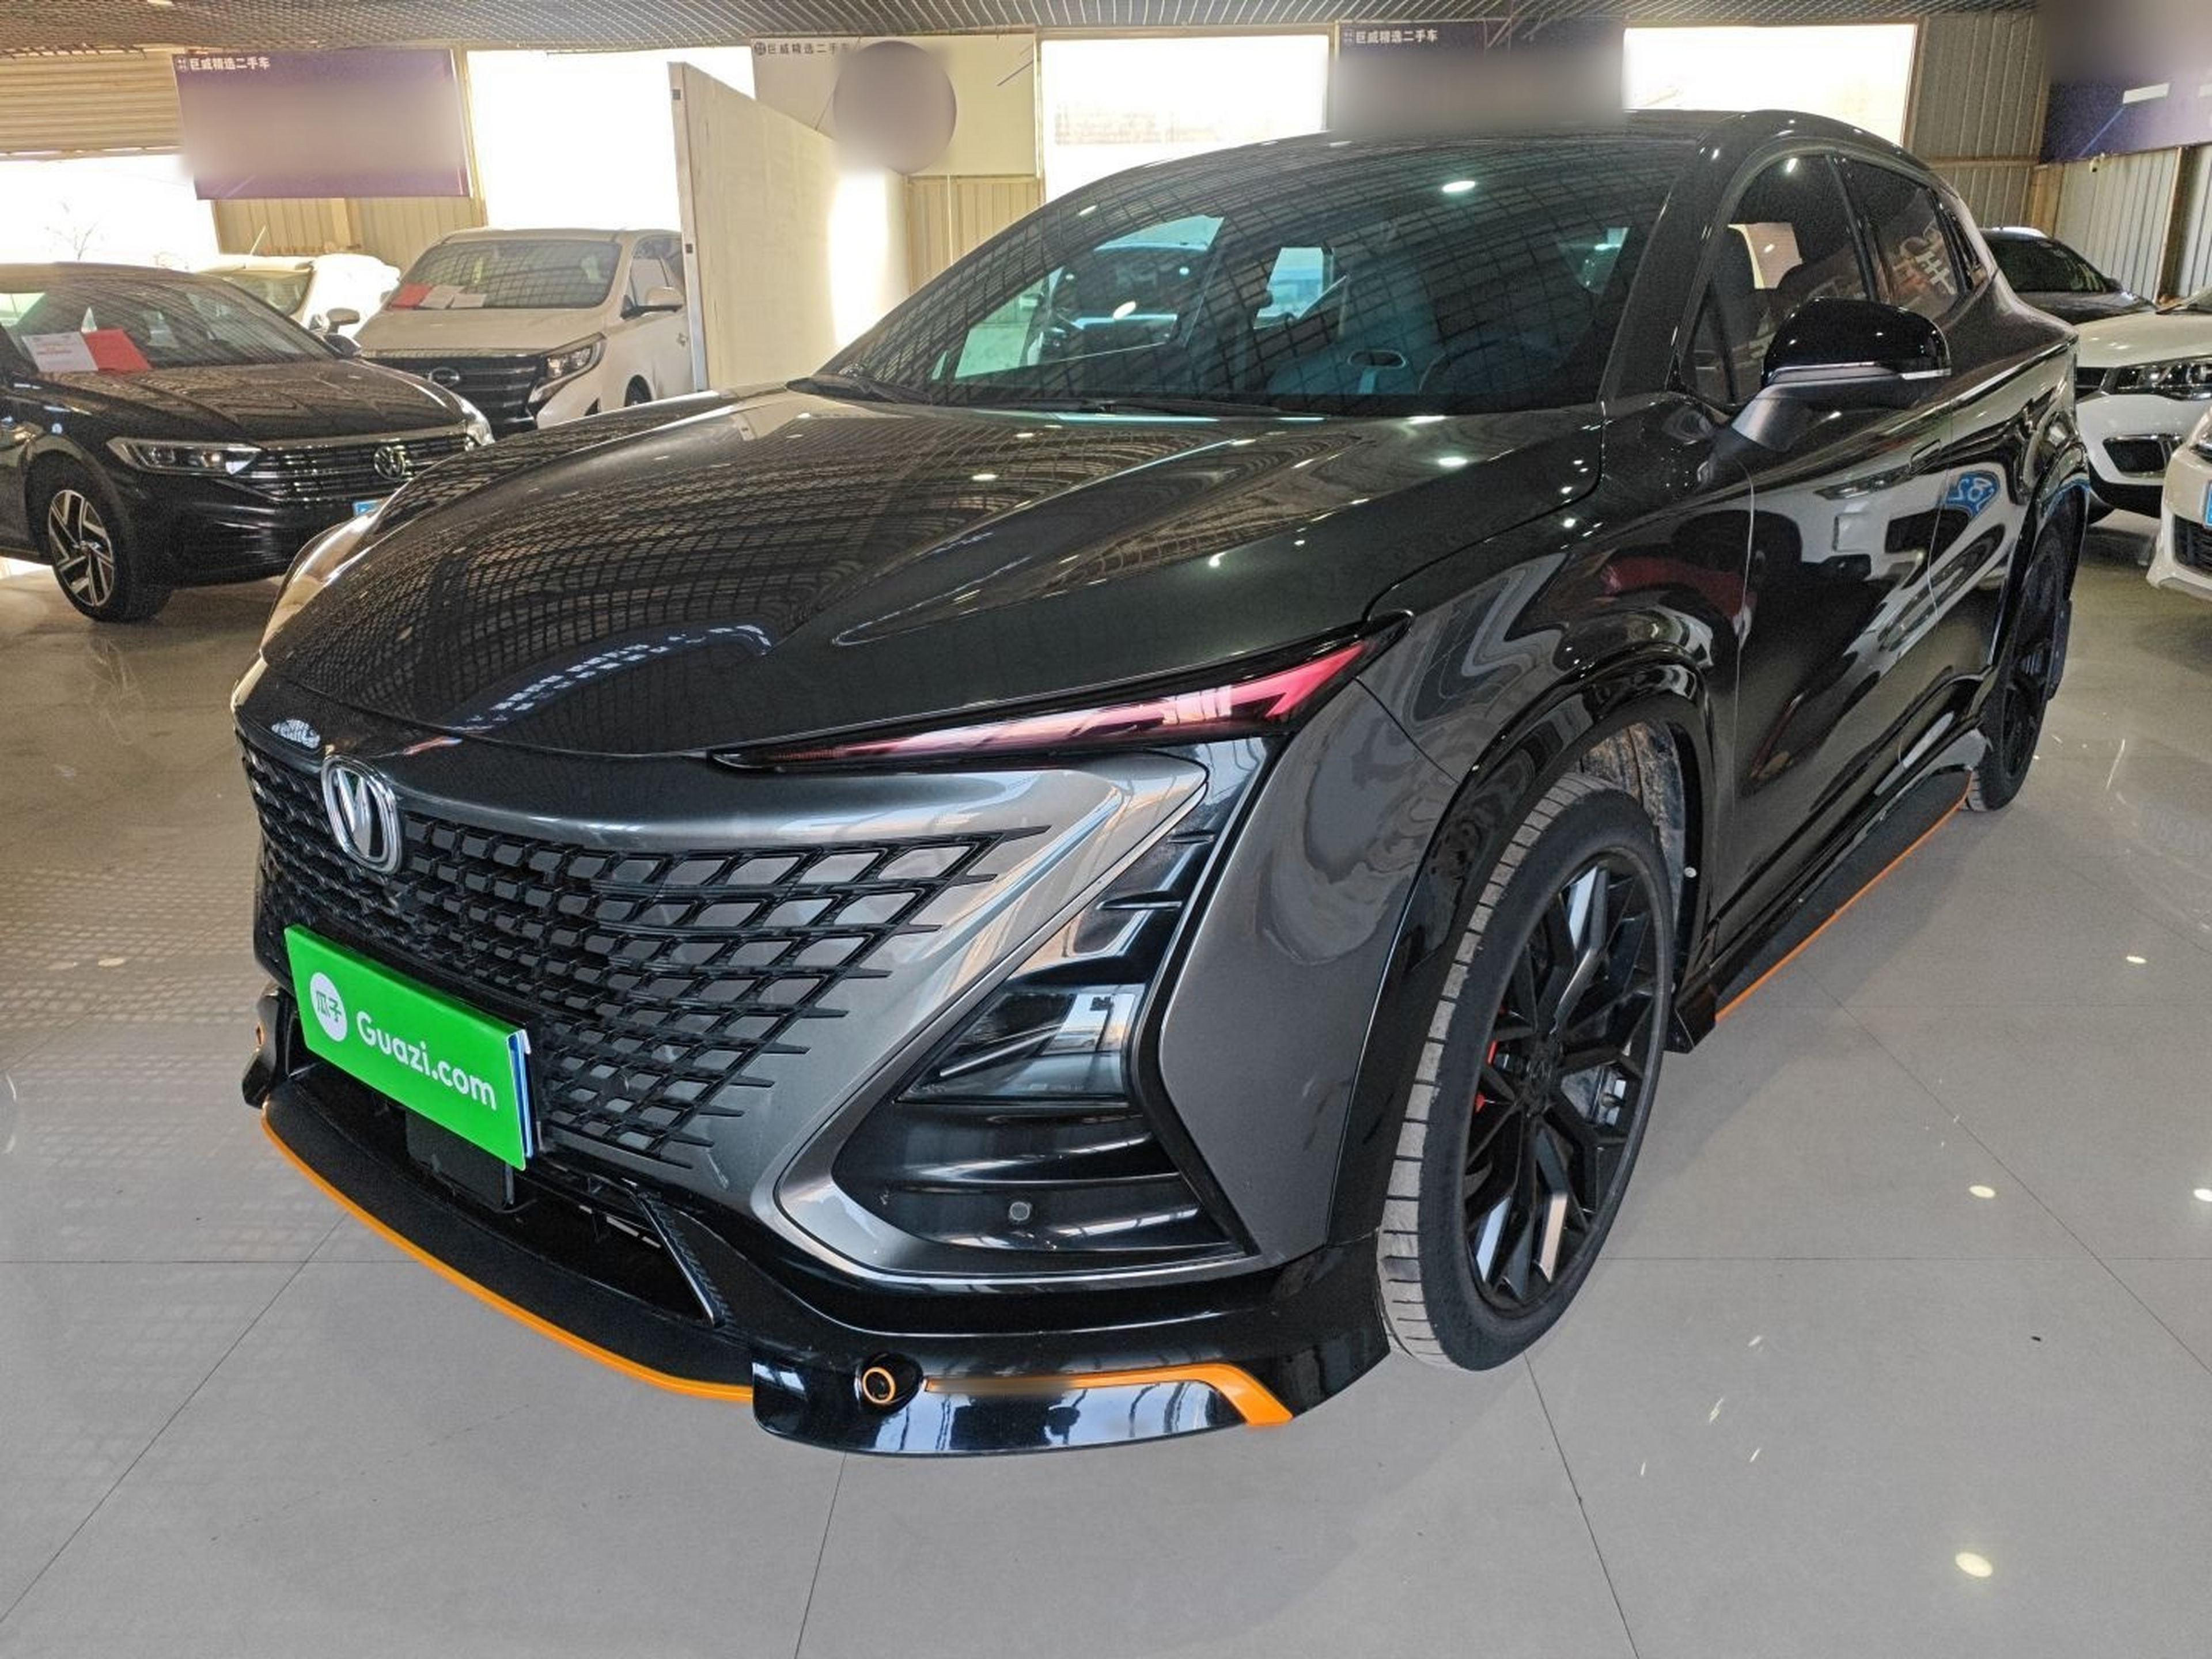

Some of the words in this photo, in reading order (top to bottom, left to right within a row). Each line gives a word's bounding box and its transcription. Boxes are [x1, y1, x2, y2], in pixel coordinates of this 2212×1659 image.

[1355, 29, 1438, 44] 巨威精选二手车
[189, 56, 271, 70] 巨威精选二手车
[316, 990, 342, 1022] 瓜子
[357, 1010, 497, 1111] Guazi.com
